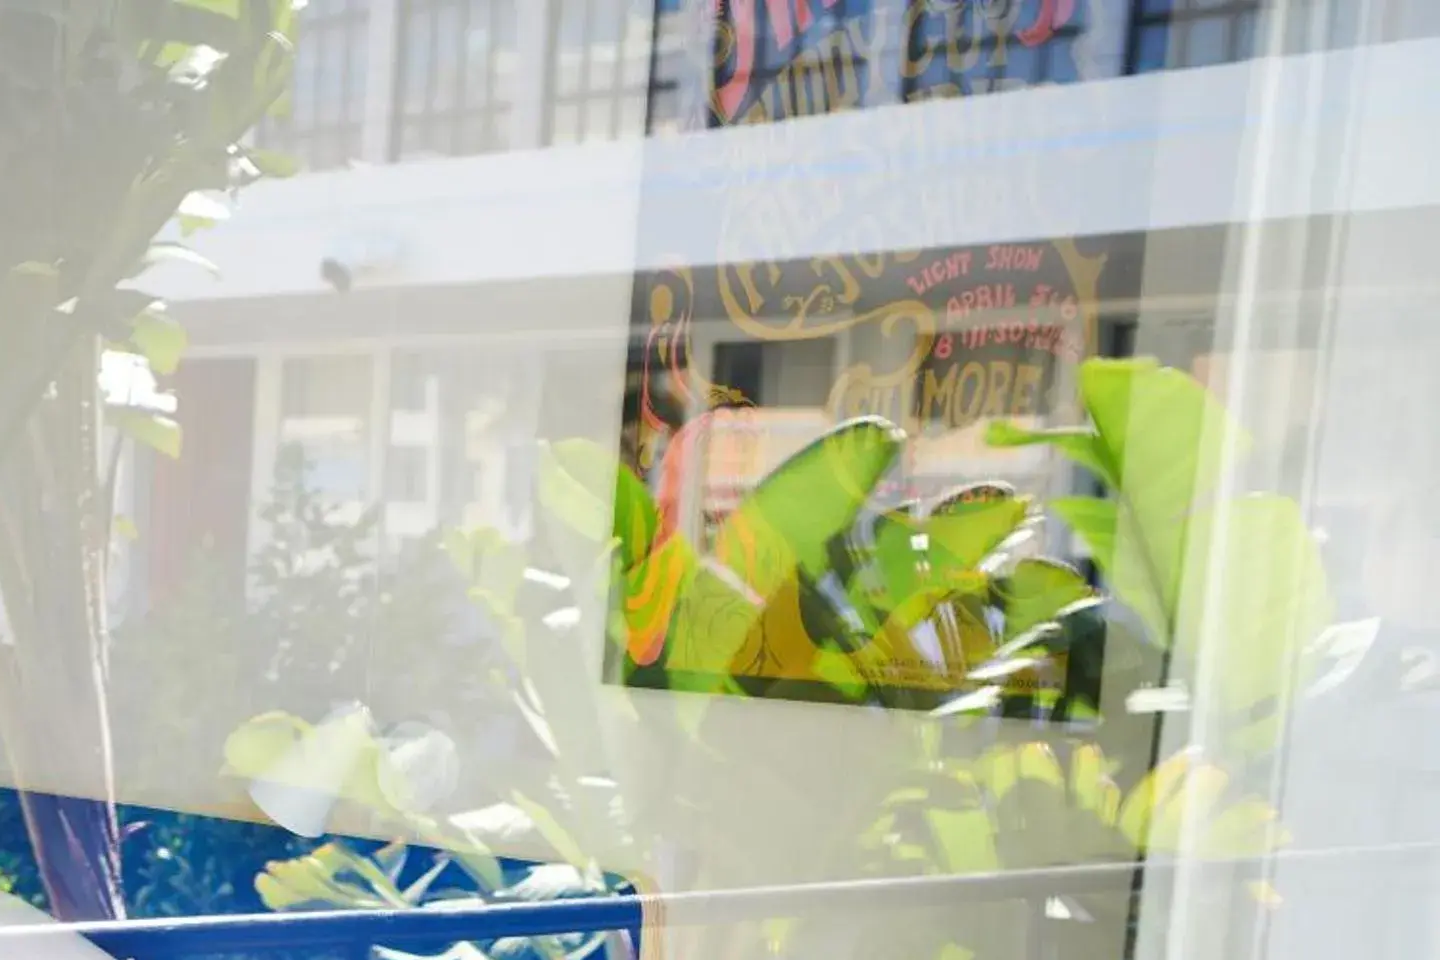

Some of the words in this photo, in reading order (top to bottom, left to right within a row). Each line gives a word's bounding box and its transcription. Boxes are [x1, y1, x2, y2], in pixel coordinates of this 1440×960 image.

[746, 6, 889, 125] UDDY
[905, 250, 972, 296] LIGHT
[985, 244, 1044, 273] SHOW
[946, 282, 1016, 319] APRIL
